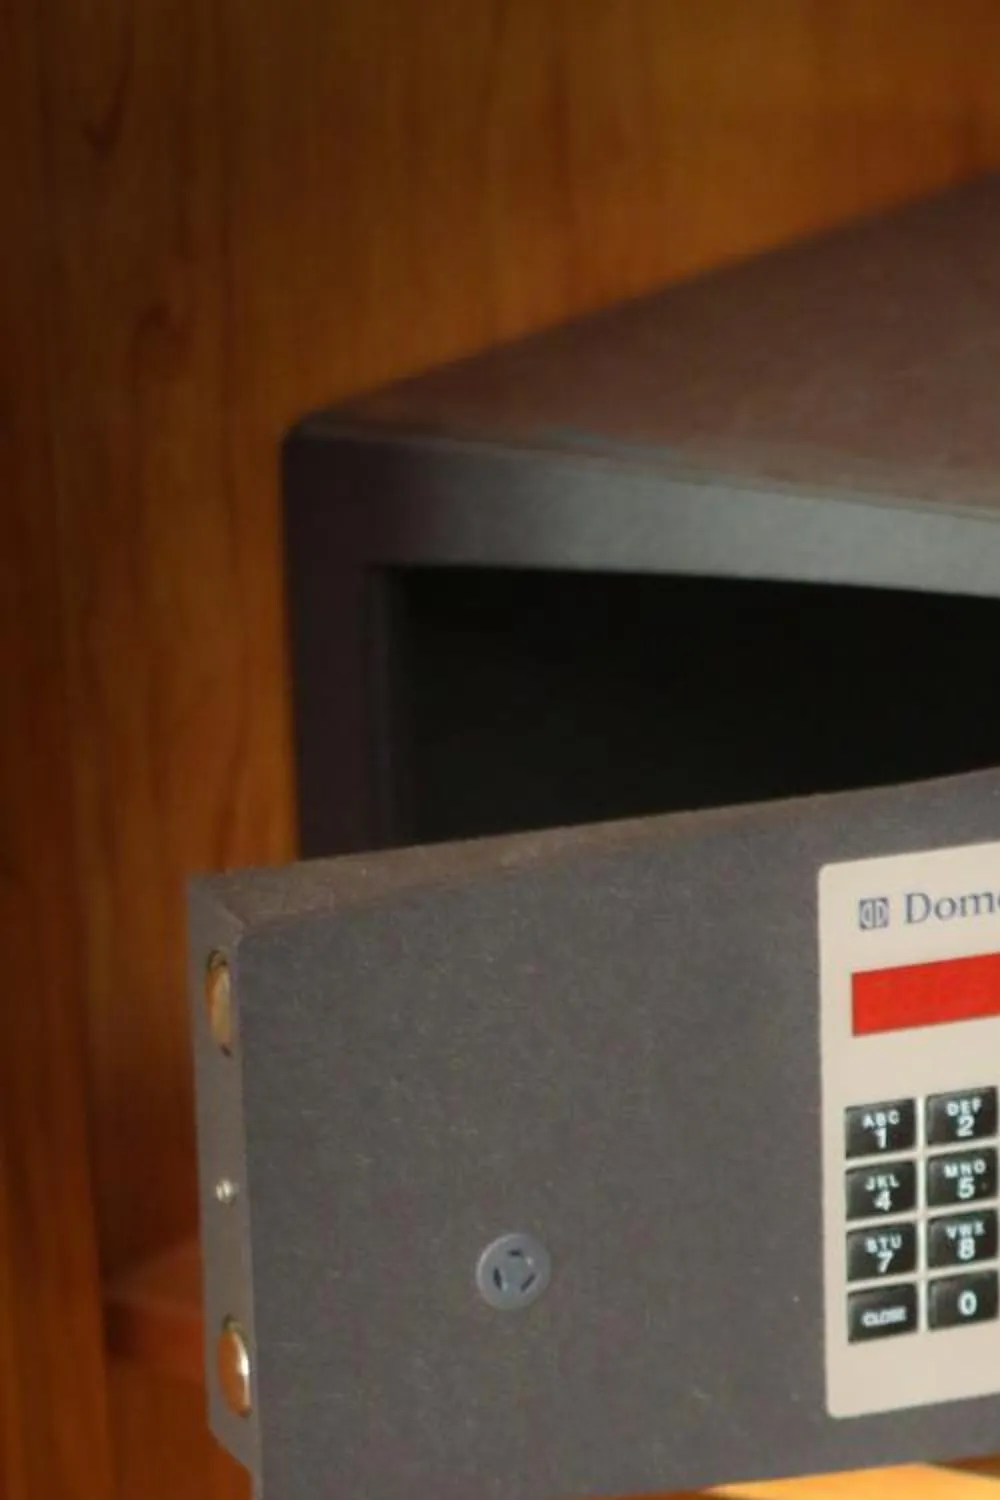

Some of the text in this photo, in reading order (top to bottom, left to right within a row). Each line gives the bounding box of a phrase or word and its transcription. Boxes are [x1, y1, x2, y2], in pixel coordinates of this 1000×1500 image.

[946, 1099, 982, 1116] DEF
[862, 1110, 899, 1128] ABC
[956, 1115, 975, 1137] 2
[874, 1127, 887, 1149] 1
[956, 1176, 975, 1199] 5
[874, 1190, 892, 1212] 4
[957, 1237, 976, 1260] 8
[876, 1250, 894, 1273] 7
[958, 1290, 978, 1316] 0
